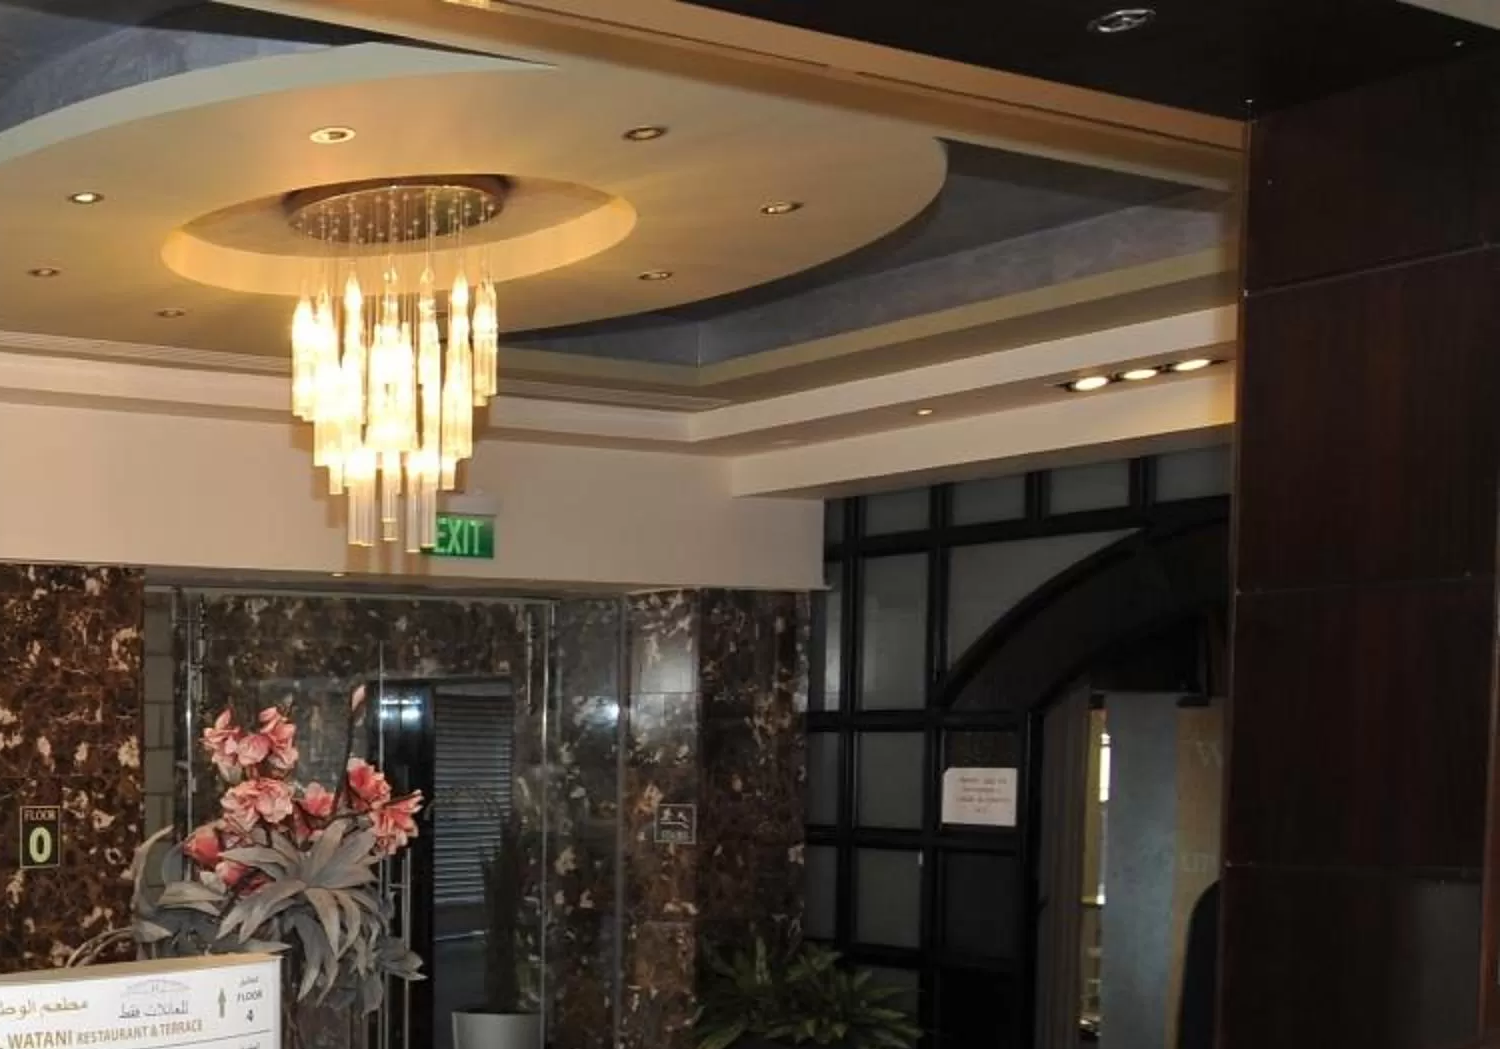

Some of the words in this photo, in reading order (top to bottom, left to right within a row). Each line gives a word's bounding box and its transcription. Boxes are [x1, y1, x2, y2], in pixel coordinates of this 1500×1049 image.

[436, 517, 484, 556] EXIT
[29, 826, 52, 863] 0
[236, 989, 263, 1003] FLOOR
[76, 1025, 149, 1045] RESTAURANT
[160, 1018, 203, 1037] TERRACE
